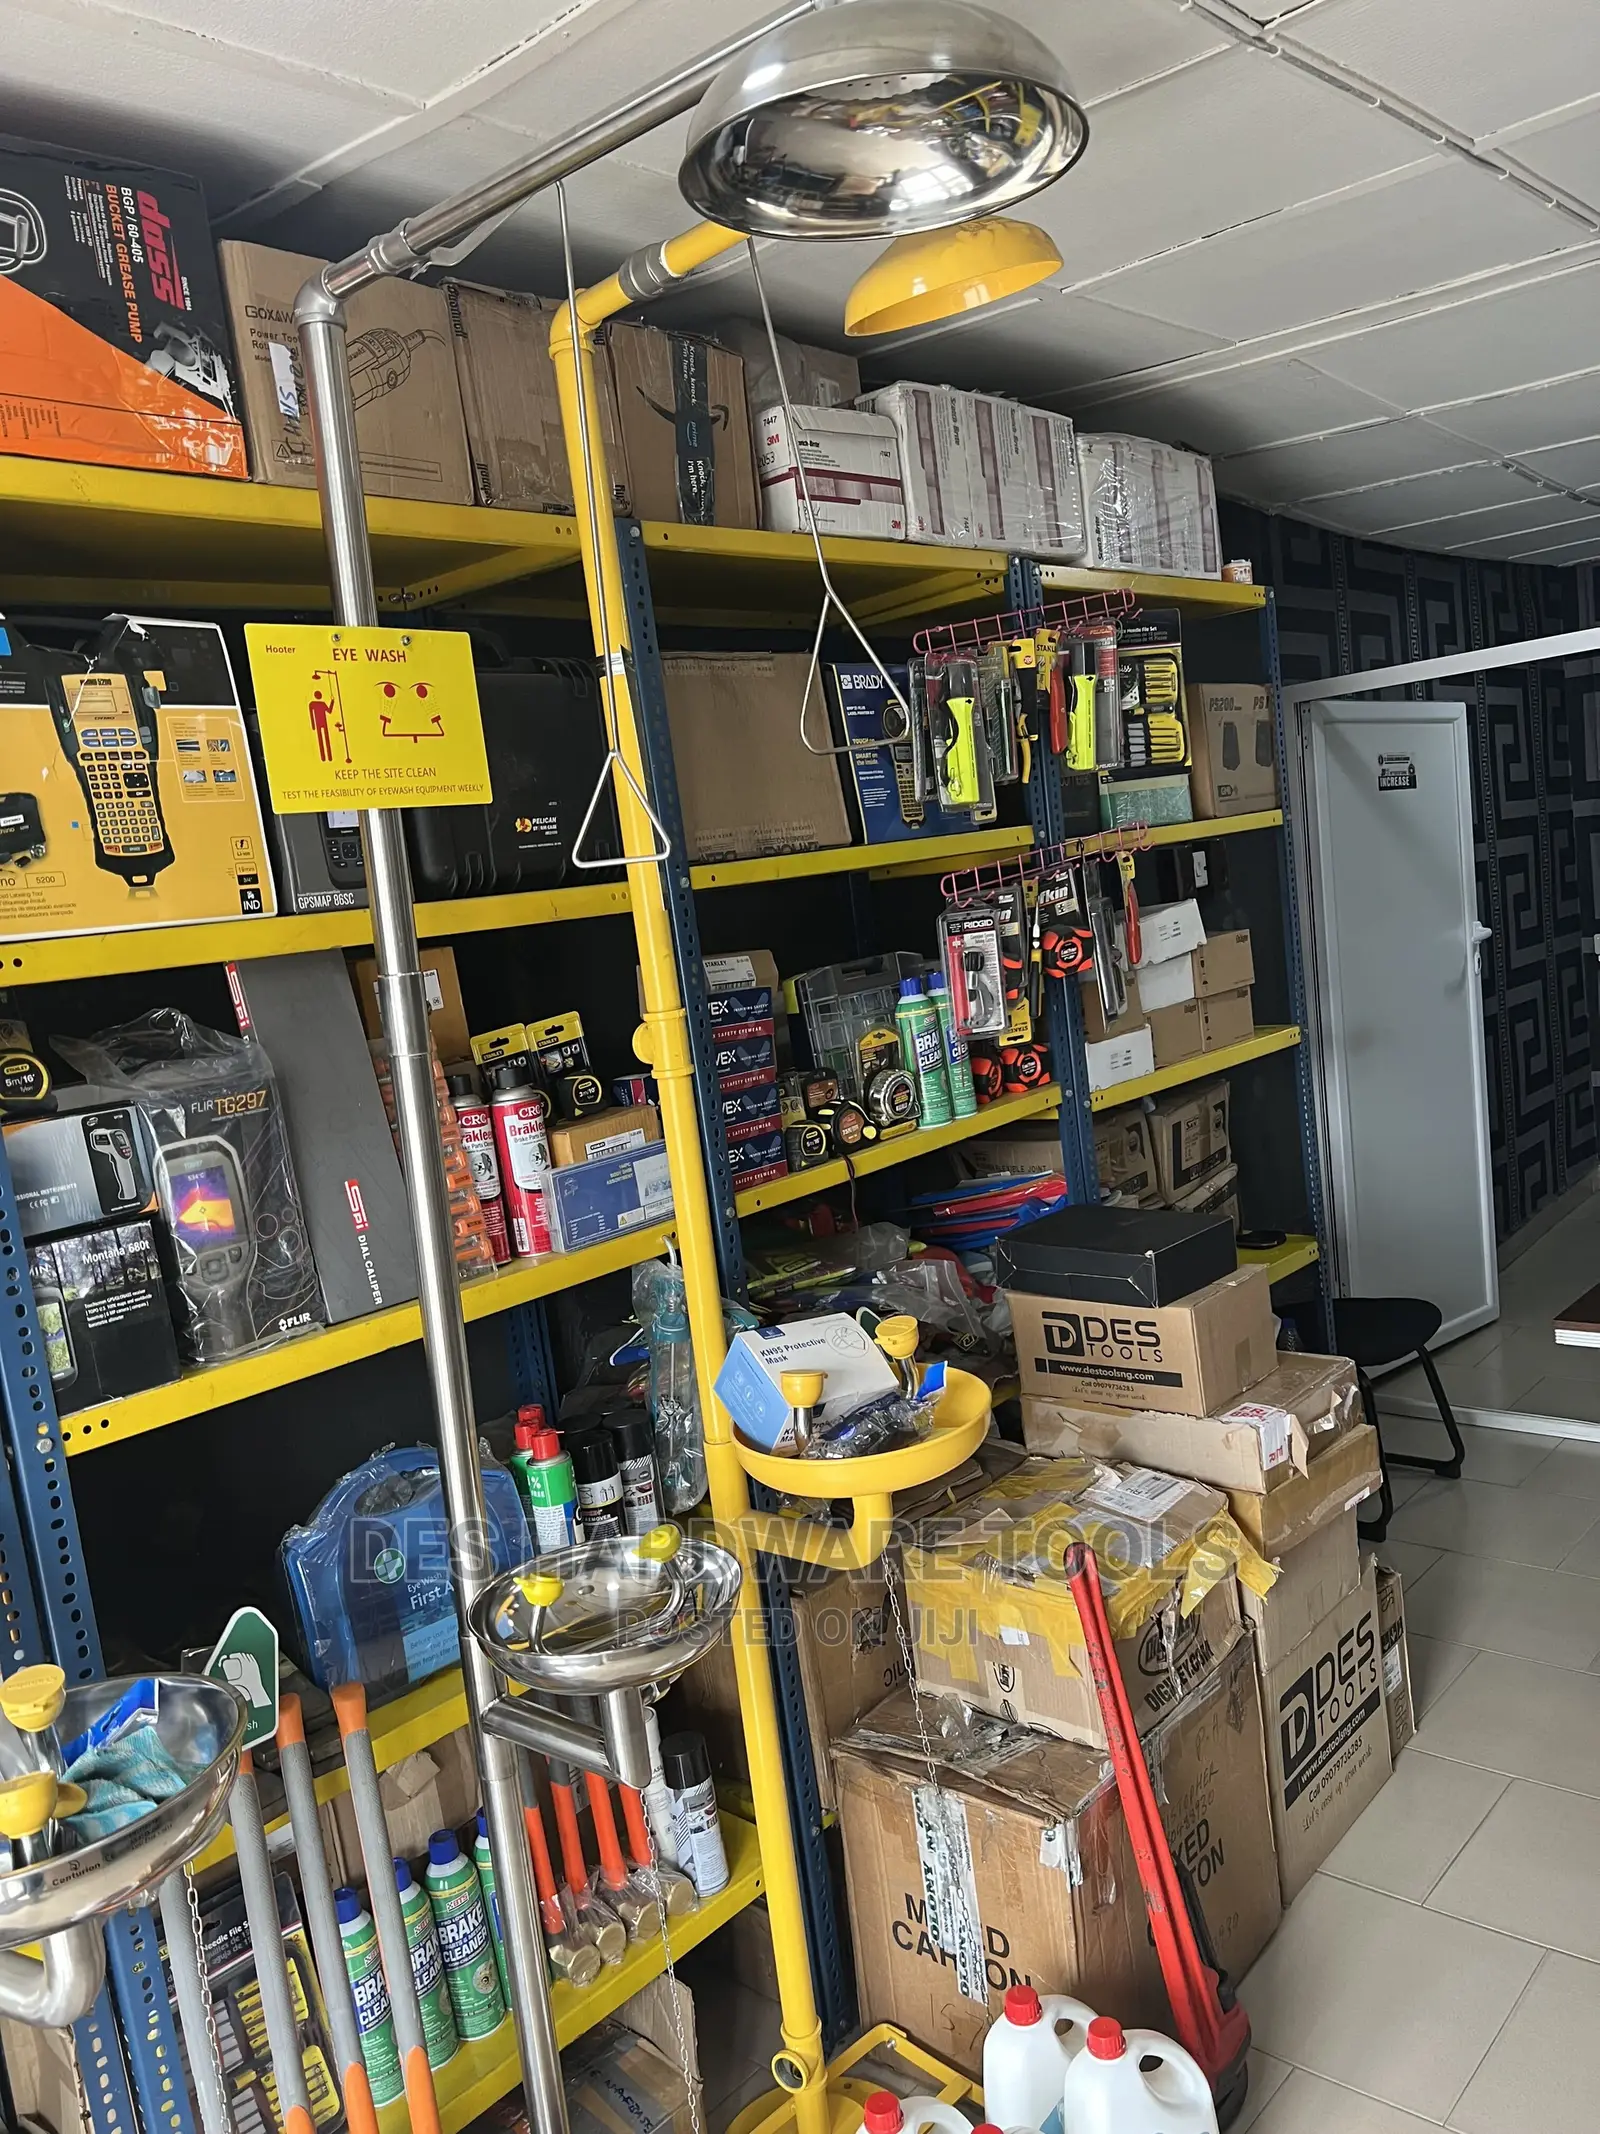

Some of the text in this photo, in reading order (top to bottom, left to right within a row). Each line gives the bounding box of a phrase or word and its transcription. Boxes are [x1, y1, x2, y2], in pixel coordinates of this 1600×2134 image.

[121, 186, 135, 217] BGP
[106, 184, 126, 240] BUCKET
[127, 223, 144, 263] 60-405
[115, 243, 136, 299] GREASE
[126, 302, 143, 343] PUMP
[766, 434, 780, 447] 3M
[891, 520, 902, 530] 3M
[265, 644, 296, 654] Hooter
[332, 648, 407, 663] EYE WASH
[853, 675, 885, 689] BRADY
[335, 767, 437, 780] KEEP THE SITE CLEAN
[1379, 776, 1410, 787] INCREASE
[282, 783, 484, 800] TEST THE FEASIBILITY OF EYEWASH EQUIPMENT WEEKLY
[532, 816, 557, 825] PELICAN
[243, 900, 261, 912] IND
[297, 896, 332, 910] GPSMAP
[963, 919, 994, 930] RIDGID
[705, 959, 727, 968] STANLEY
[538, 1037, 558, 1047] STANLEY
[191, 1100, 214, 1114] FLIR
[214, 1090, 267, 1116] TG297
[461, 1114, 488, 1126] CRC
[519, 1106, 541, 1120] CRC
[82, 1240, 151, 1265] Montana 680t
[357, 1234, 383, 1306] DIAL CALIPER
[287, 1311, 312, 1329] FLIR
[1083, 1316, 1161, 1348] DES
[760, 1338, 827, 1358] KN95 Protective
[1086, 1343, 1164, 1363] TOOLS
[766, 1354, 789, 1365] Mask
[1059, 1363, 1155, 1382] www.destoolsng.com
[1081, 1379, 1093, 1388] Call
[407, 1572, 443, 1594] Eye Wash
[410, 1587, 443, 1609] First
[1316, 1610, 1375, 1707] DES
[1317, 1658, 1377, 1736] TOOLS
[247, 1719, 258, 1731] sh
[1299, 1708, 1366, 1784] www.destoolsng.com
[1308, 1783, 1321, 1803] Call
[52, 1861, 101, 1887] Centurion
[438, 1900, 485, 1945] BRAKE
[203, 1925, 243, 1951] Needle File
[443, 1925, 488, 1964] CLEANER
